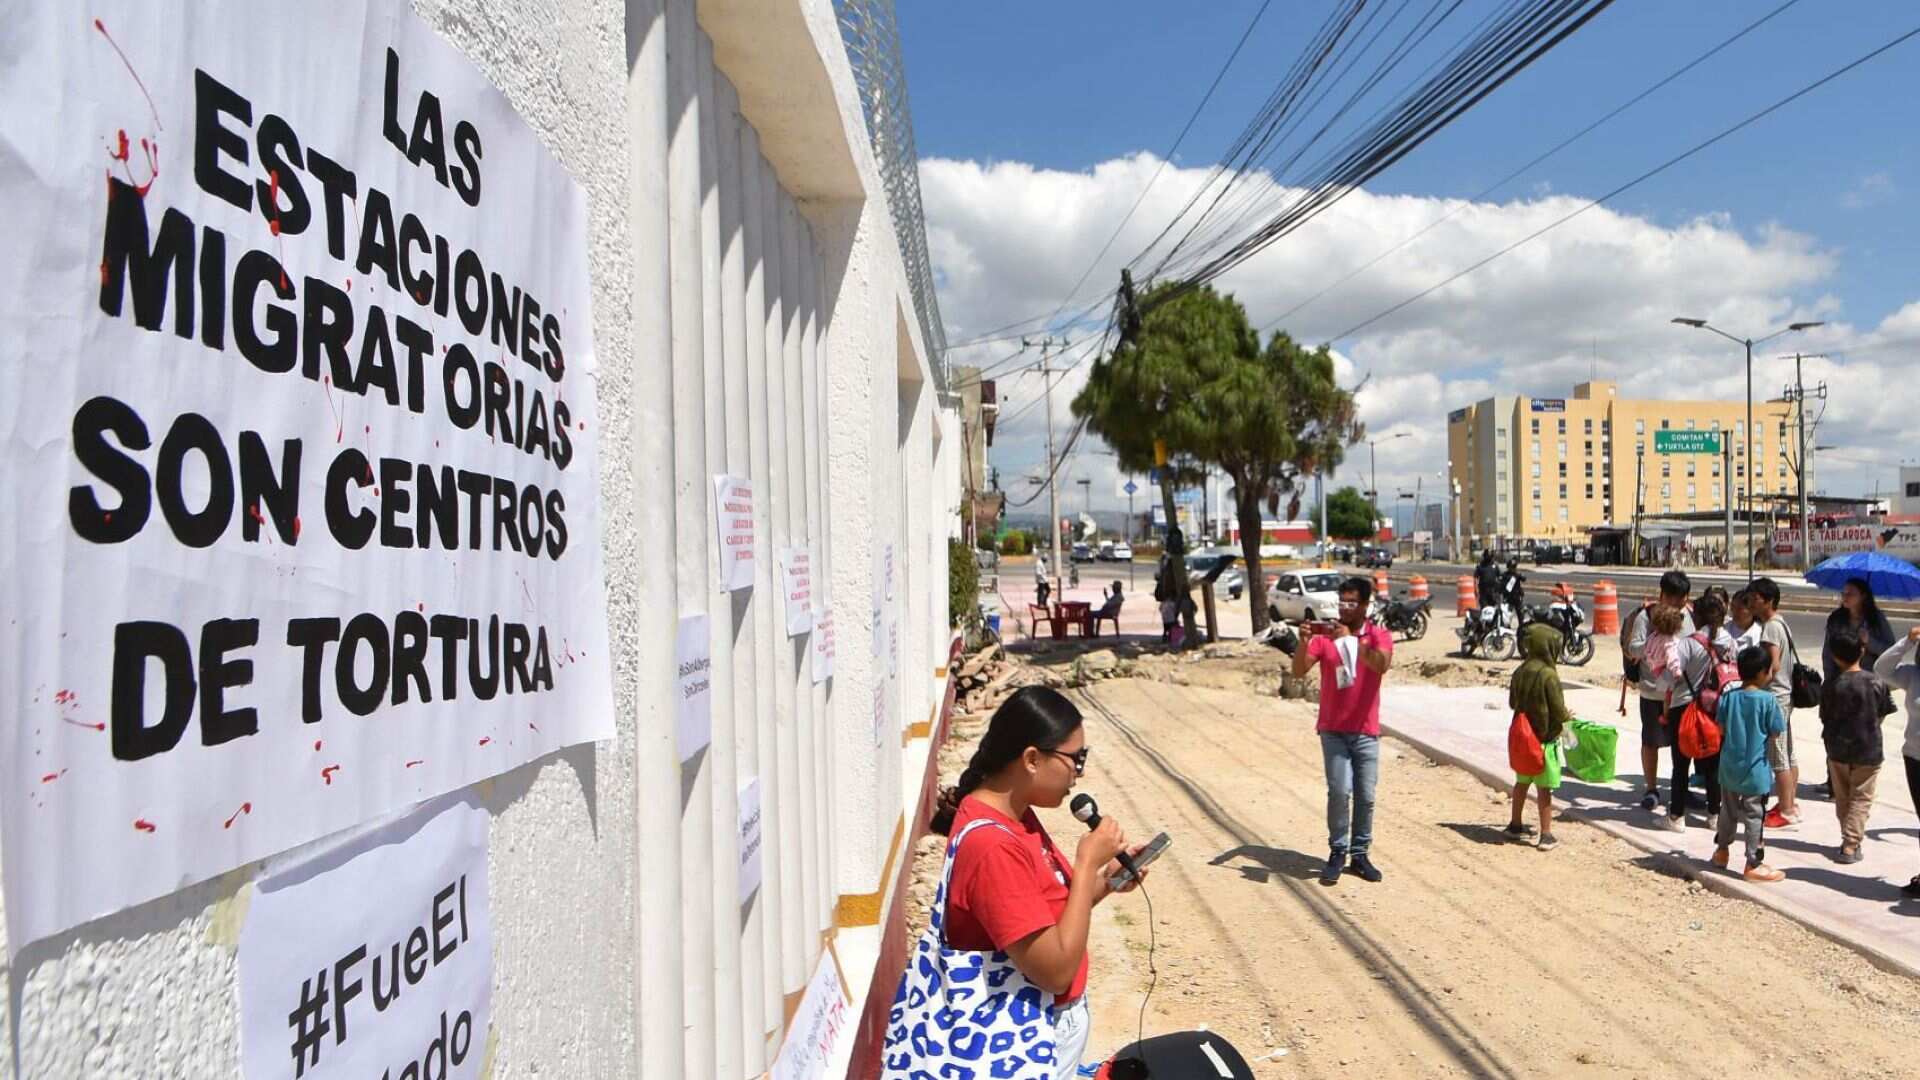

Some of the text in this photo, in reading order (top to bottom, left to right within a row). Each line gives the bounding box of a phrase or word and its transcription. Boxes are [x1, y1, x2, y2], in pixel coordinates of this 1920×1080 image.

[383, 47, 482, 207] LAS
[194, 68, 565, 383] ESTACIONES
[98, 175, 573, 471] MIGRATORIAS
[68, 396, 302, 548] SON
[325, 448, 568, 561] CENTROS
[1664, 443, 1690, 451] TUXTLA
[1671, 433, 1703, 442] COMITAN
[1774, 529, 1800, 542] VENTA
[1820, 528, 1872, 541] TABLAROCA
[111, 610, 554, 762] DE TORTURA
[289, 873, 470, 1079] #FueEl
